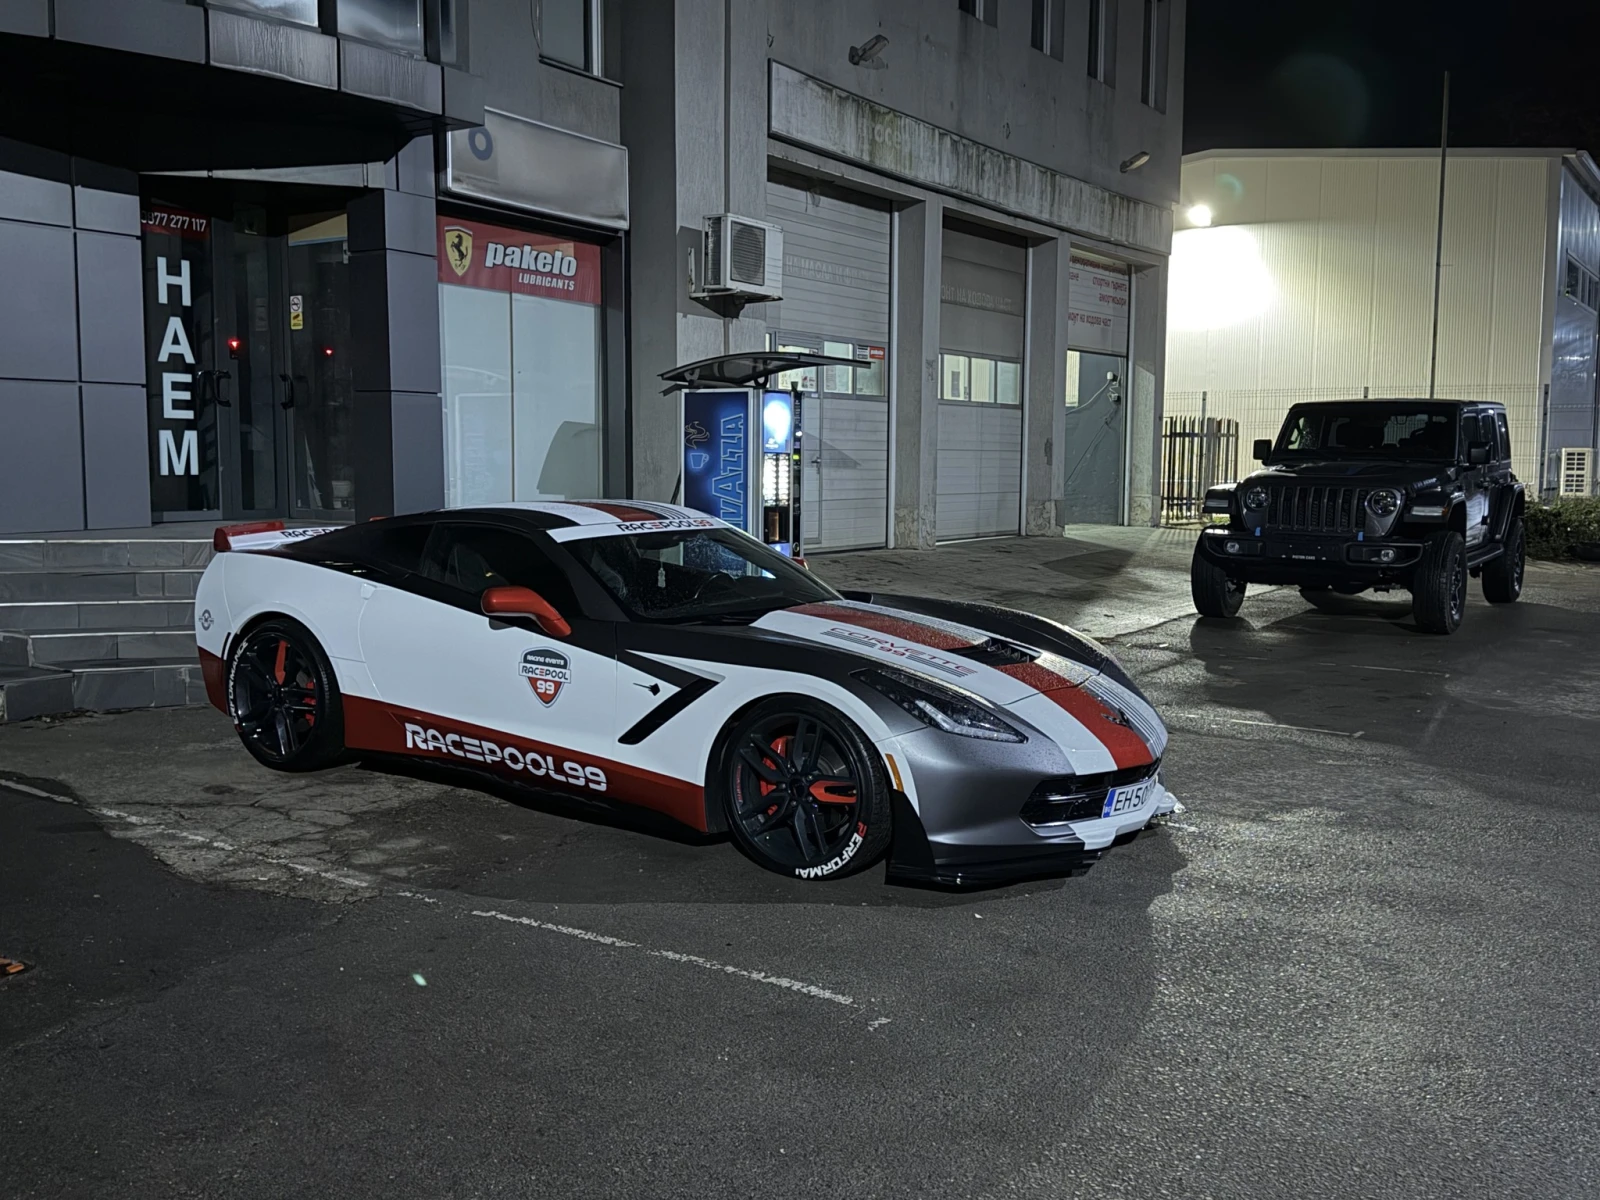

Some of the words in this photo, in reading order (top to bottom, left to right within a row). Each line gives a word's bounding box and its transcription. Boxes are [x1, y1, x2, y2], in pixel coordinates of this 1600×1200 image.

[170, 214, 190, 230] 277
[192, 218, 207, 232] 117
[485, 242, 577, 277] pakelo
[519, 273, 575, 291] LUBRICANTS
[830, 627, 978, 674] CORVETTE
[878, 646, 906, 657] 99
[521, 665, 569, 681] RACEPOOL
[536, 680, 555, 695] 99
[404, 722, 607, 792] RACEPOOL99
